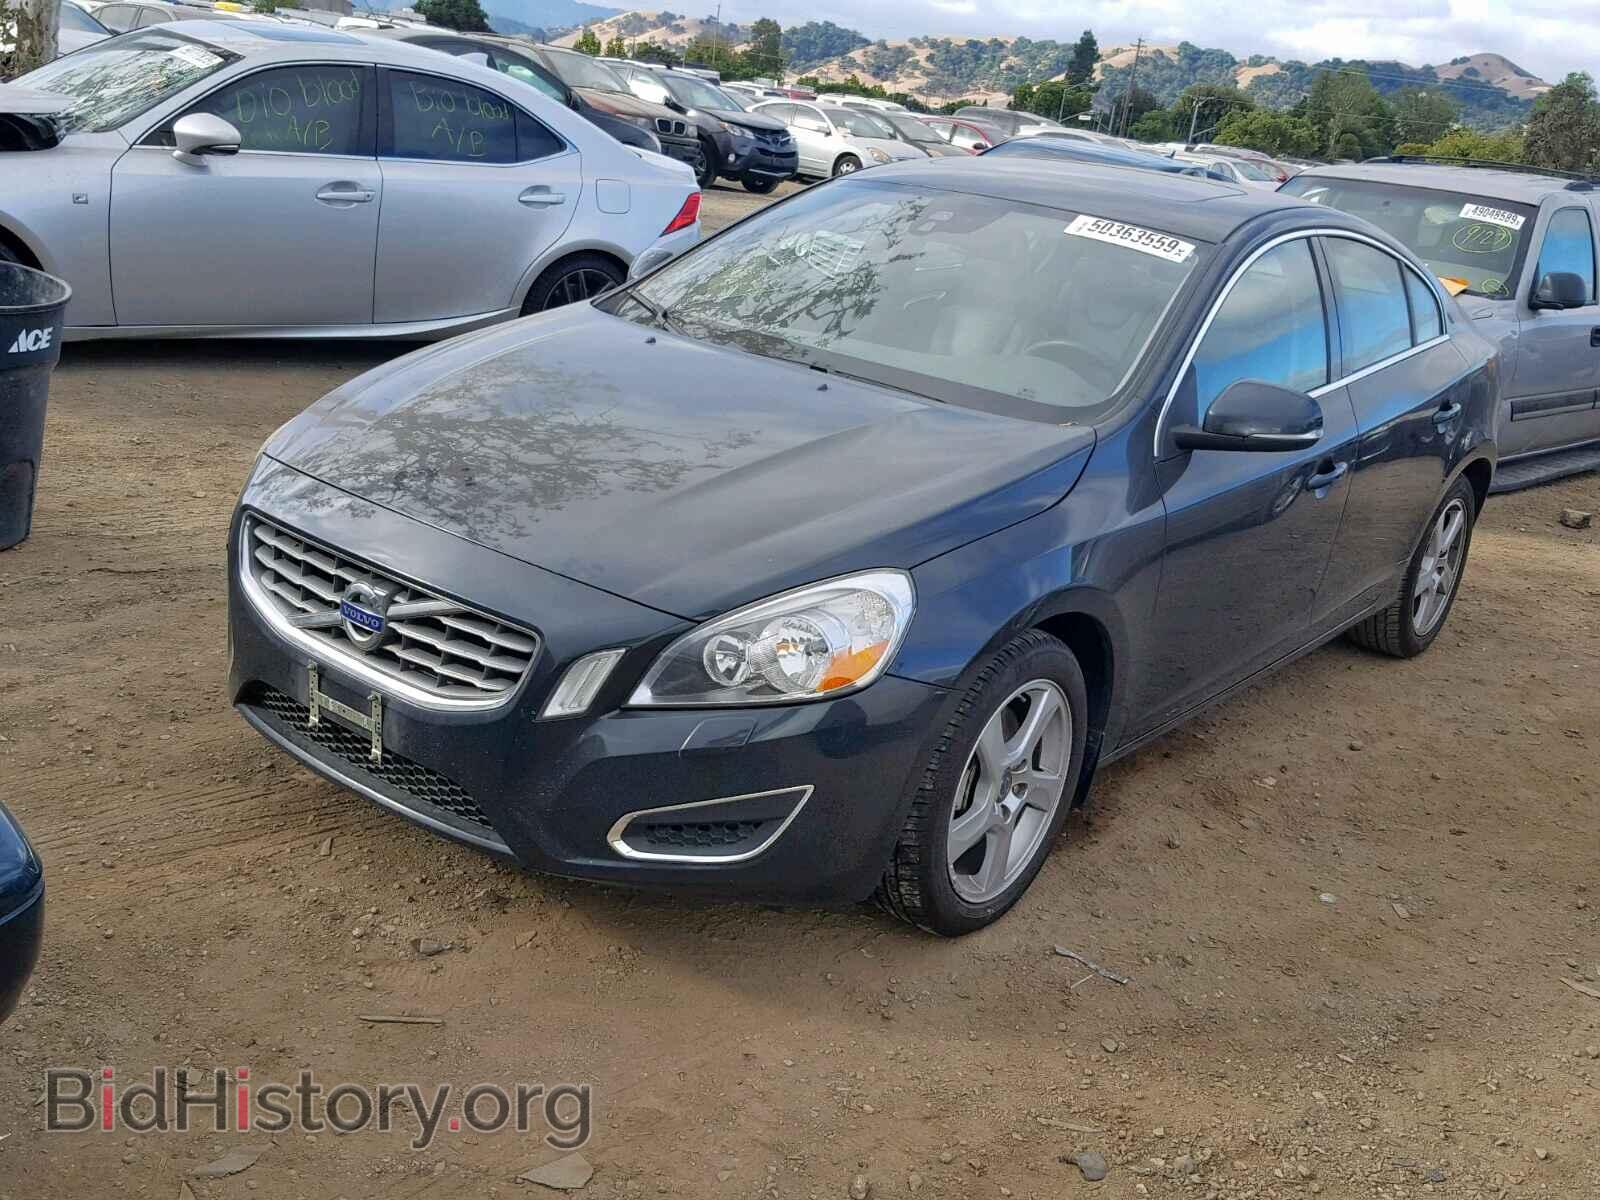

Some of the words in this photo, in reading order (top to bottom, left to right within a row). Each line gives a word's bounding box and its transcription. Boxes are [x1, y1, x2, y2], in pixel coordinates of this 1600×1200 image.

[1087, 219, 1180, 253] 50363559
[8, 326, 54, 354] ACE
[343, 604, 380, 628] VOLVO
